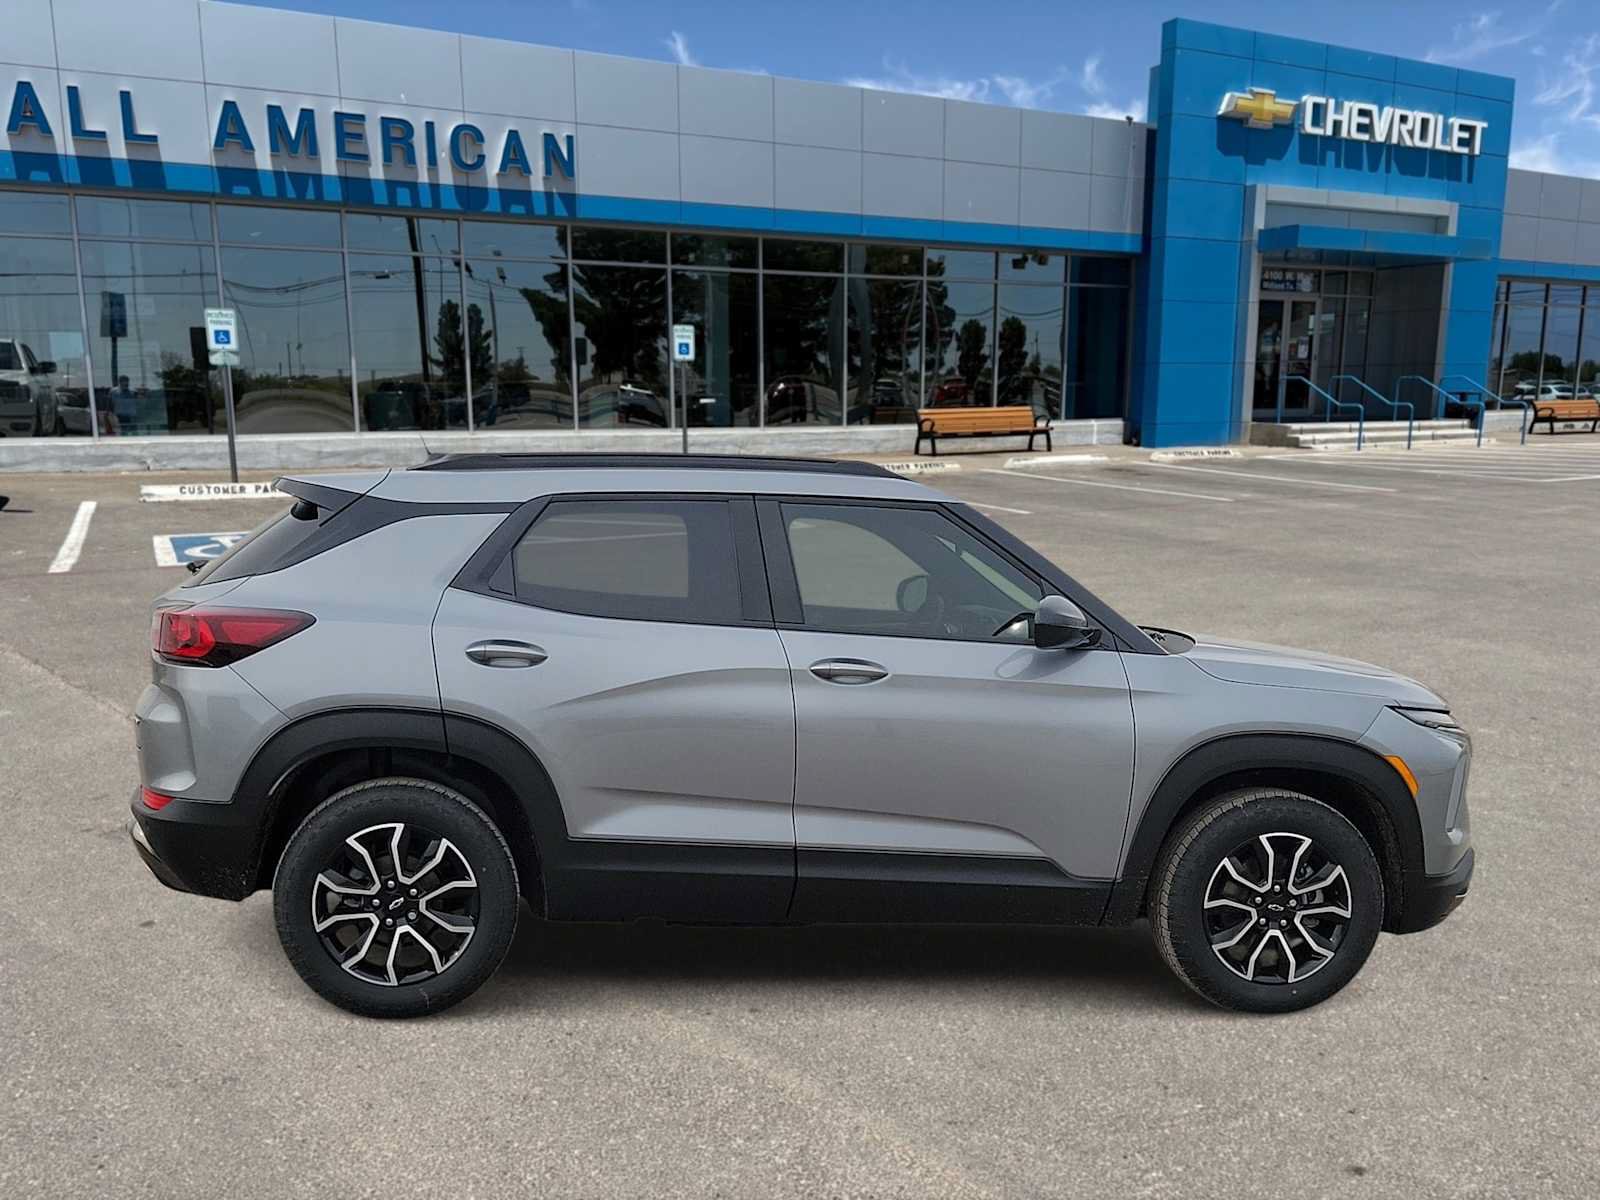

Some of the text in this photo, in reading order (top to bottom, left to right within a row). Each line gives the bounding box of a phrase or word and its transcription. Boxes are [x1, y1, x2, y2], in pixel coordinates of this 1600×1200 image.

[7, 81, 575, 178] ALL AMERICAN
[1301, 94, 1488, 155] CHEVROLET
[179, 484, 278, 495] CUSTOMER PAR
